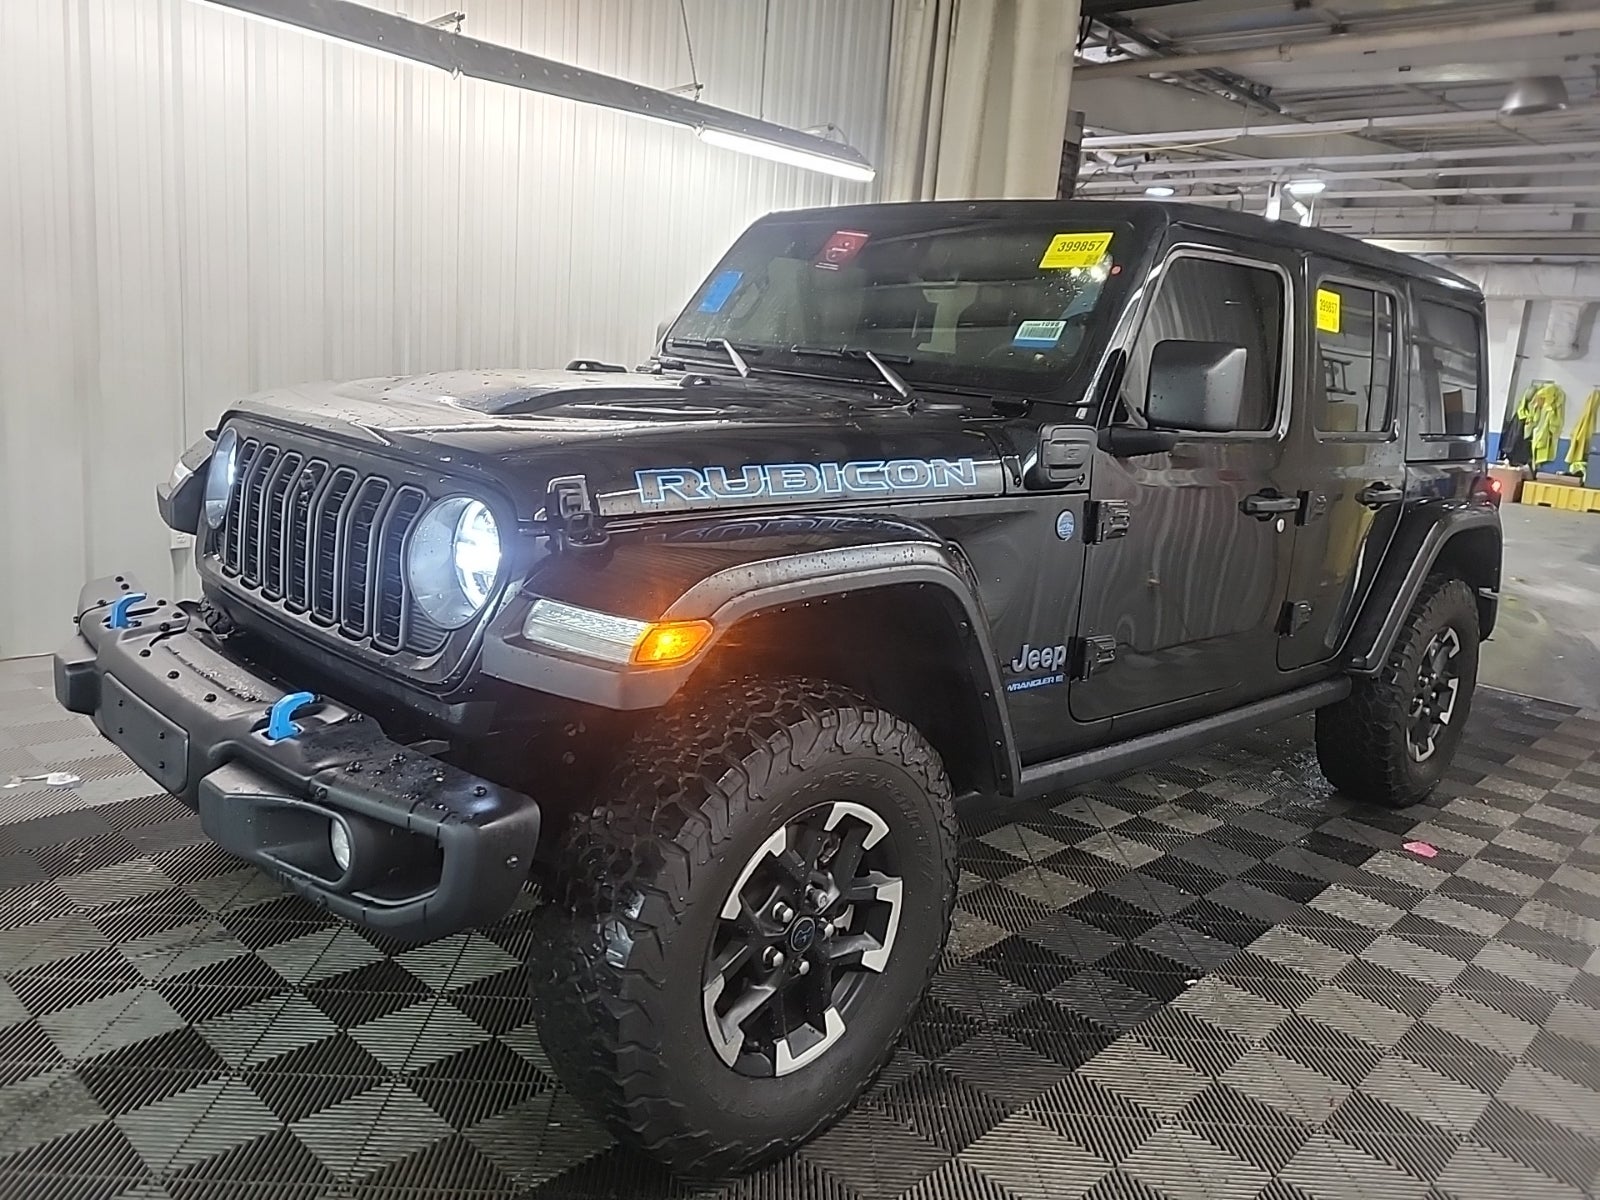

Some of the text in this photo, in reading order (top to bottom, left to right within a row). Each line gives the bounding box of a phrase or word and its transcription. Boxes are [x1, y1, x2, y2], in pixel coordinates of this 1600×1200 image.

[1057, 240, 1104, 252] 399857
[635, 457, 978, 503] RUBICON
[1011, 644, 1067, 673] Jeep
[1007, 676, 1055, 692] WRANGLER
